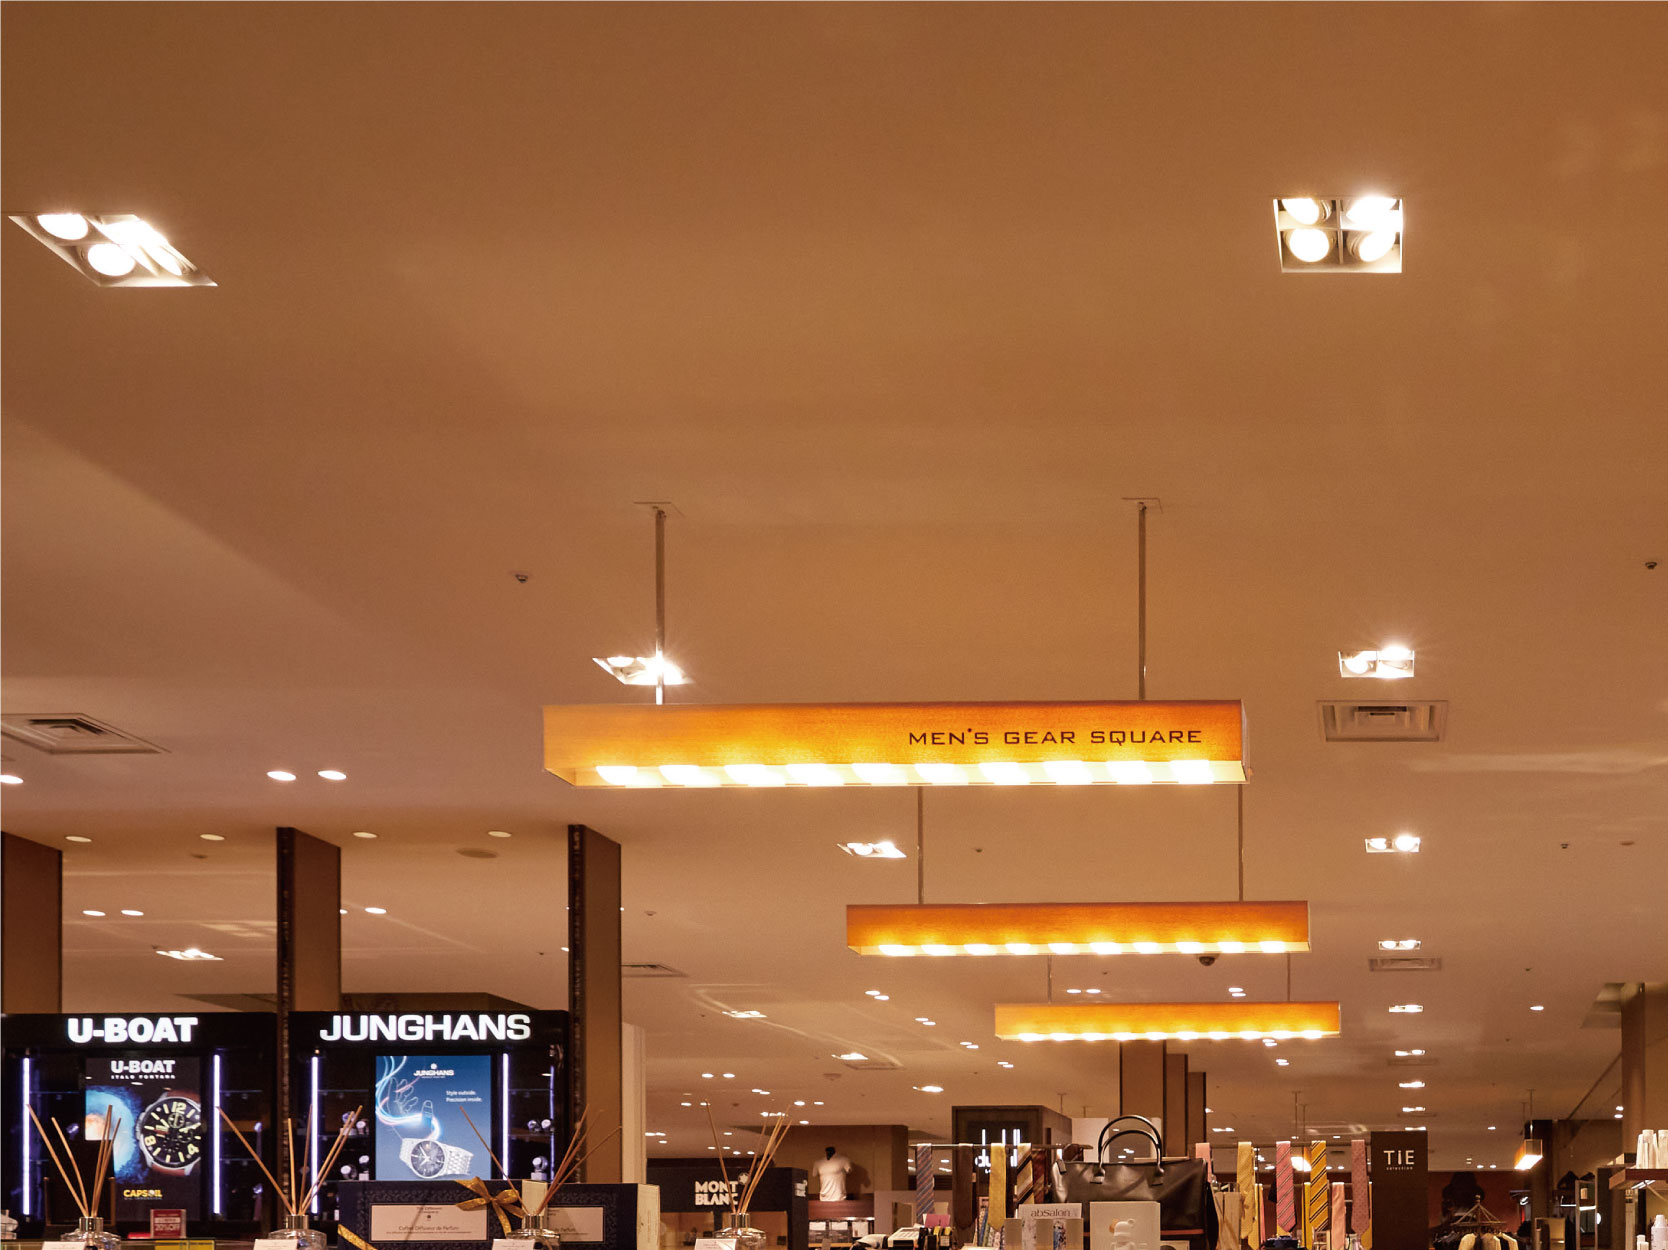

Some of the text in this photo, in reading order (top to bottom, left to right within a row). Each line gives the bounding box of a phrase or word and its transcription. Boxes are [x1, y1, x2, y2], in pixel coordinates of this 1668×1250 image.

[909, 728, 1202, 746] MEN'S GEAR SQUARE
[67, 1017, 199, 1043] U-BOAT
[319, 1014, 531, 1041] JUNGHANS
[111, 1060, 176, 1073] U-BOAT
[695, 1180, 739, 1193] MONT
[695, 1193, 739, 1206] BLANC
